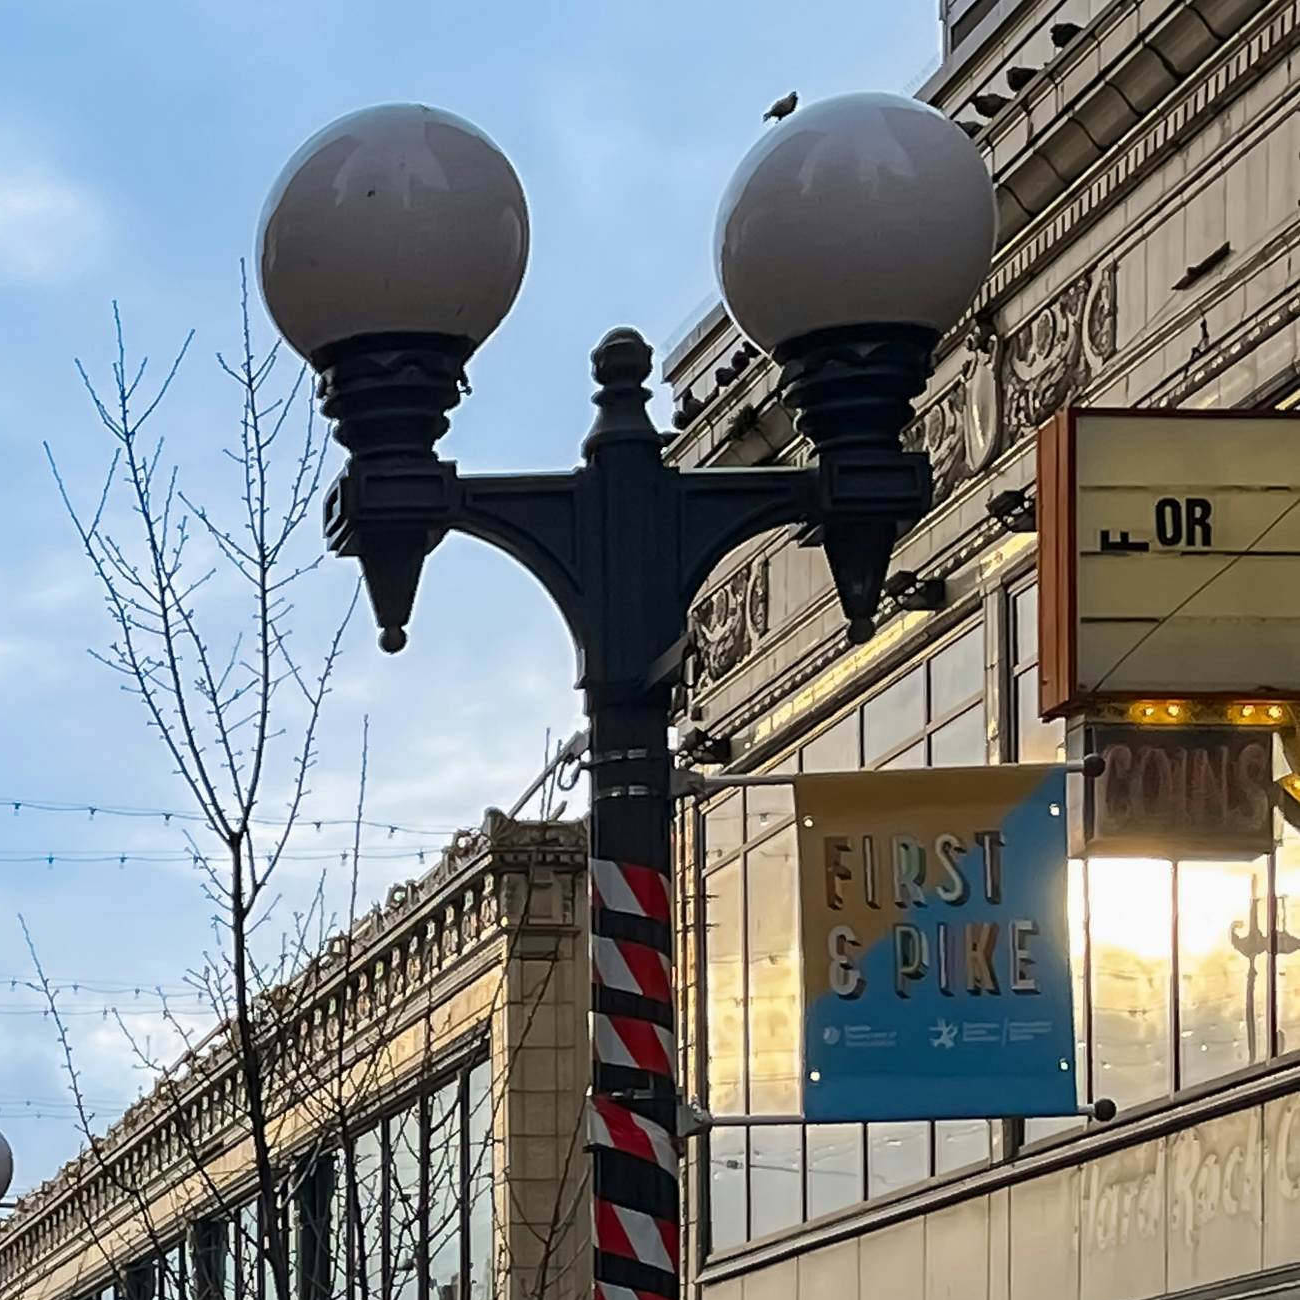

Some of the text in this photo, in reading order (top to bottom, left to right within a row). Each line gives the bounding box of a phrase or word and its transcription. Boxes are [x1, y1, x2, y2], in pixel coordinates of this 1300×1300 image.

[1155, 497, 1212, 547] OR
[824, 831, 1006, 911] FIRST
[894, 919, 1041, 998] PIKE
